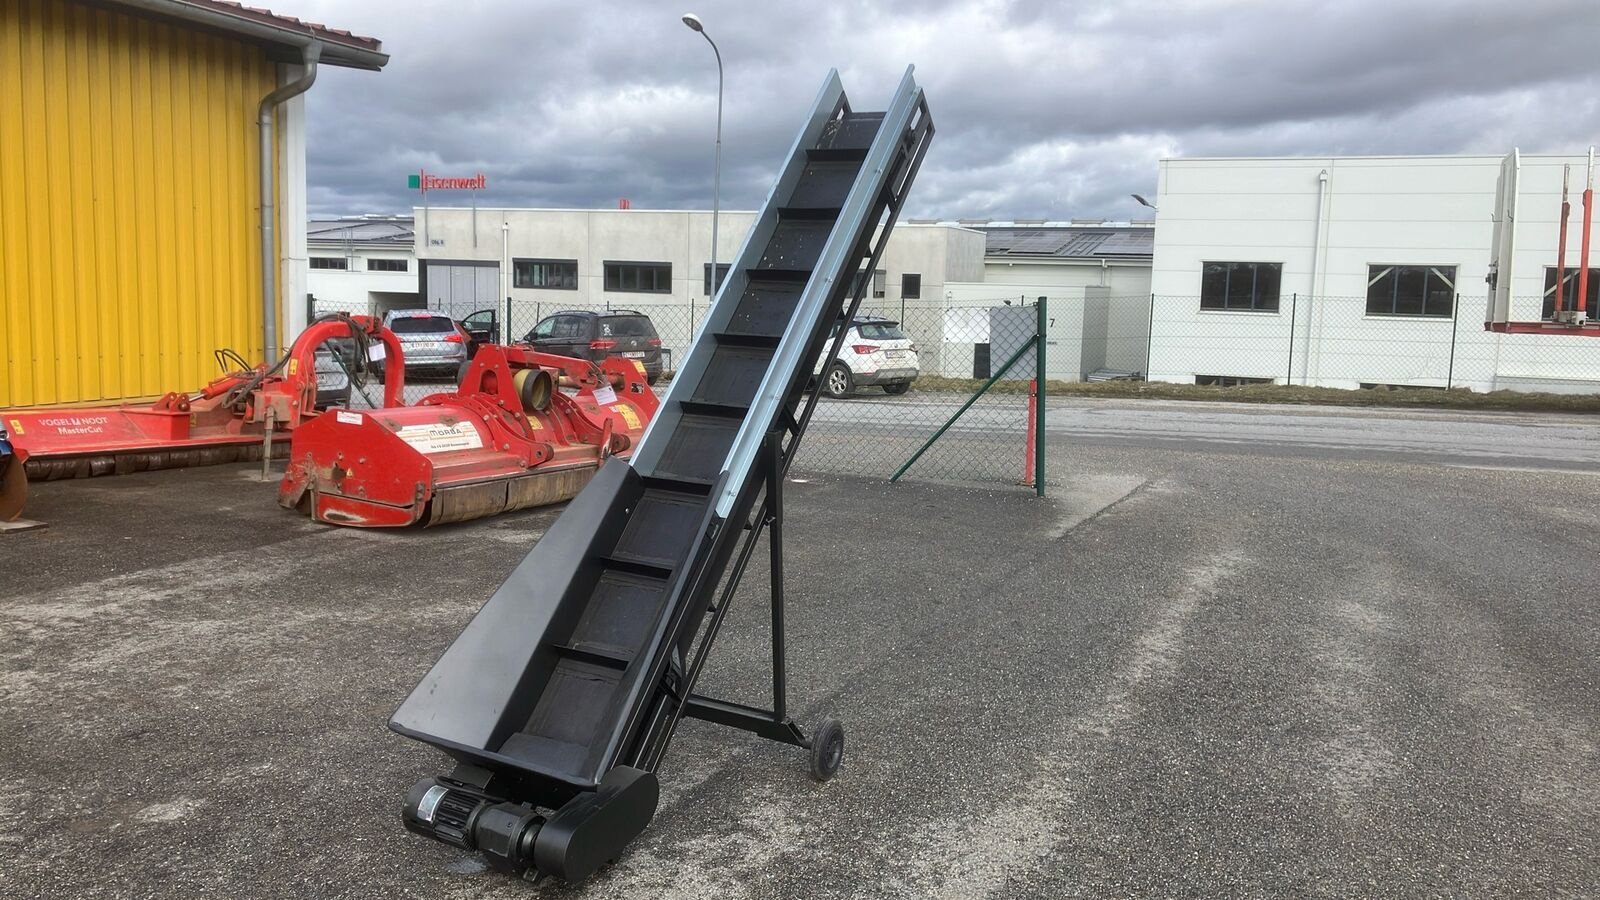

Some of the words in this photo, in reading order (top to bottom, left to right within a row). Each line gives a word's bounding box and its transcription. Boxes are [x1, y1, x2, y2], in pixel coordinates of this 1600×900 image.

[423, 174, 486, 190] Eisenwelt
[1049, 318, 1055, 328] 7
[38, 418, 73, 426] VOGEL
[81, 417, 108, 425] NOOT
[57, 426, 103, 434] MasterCut
